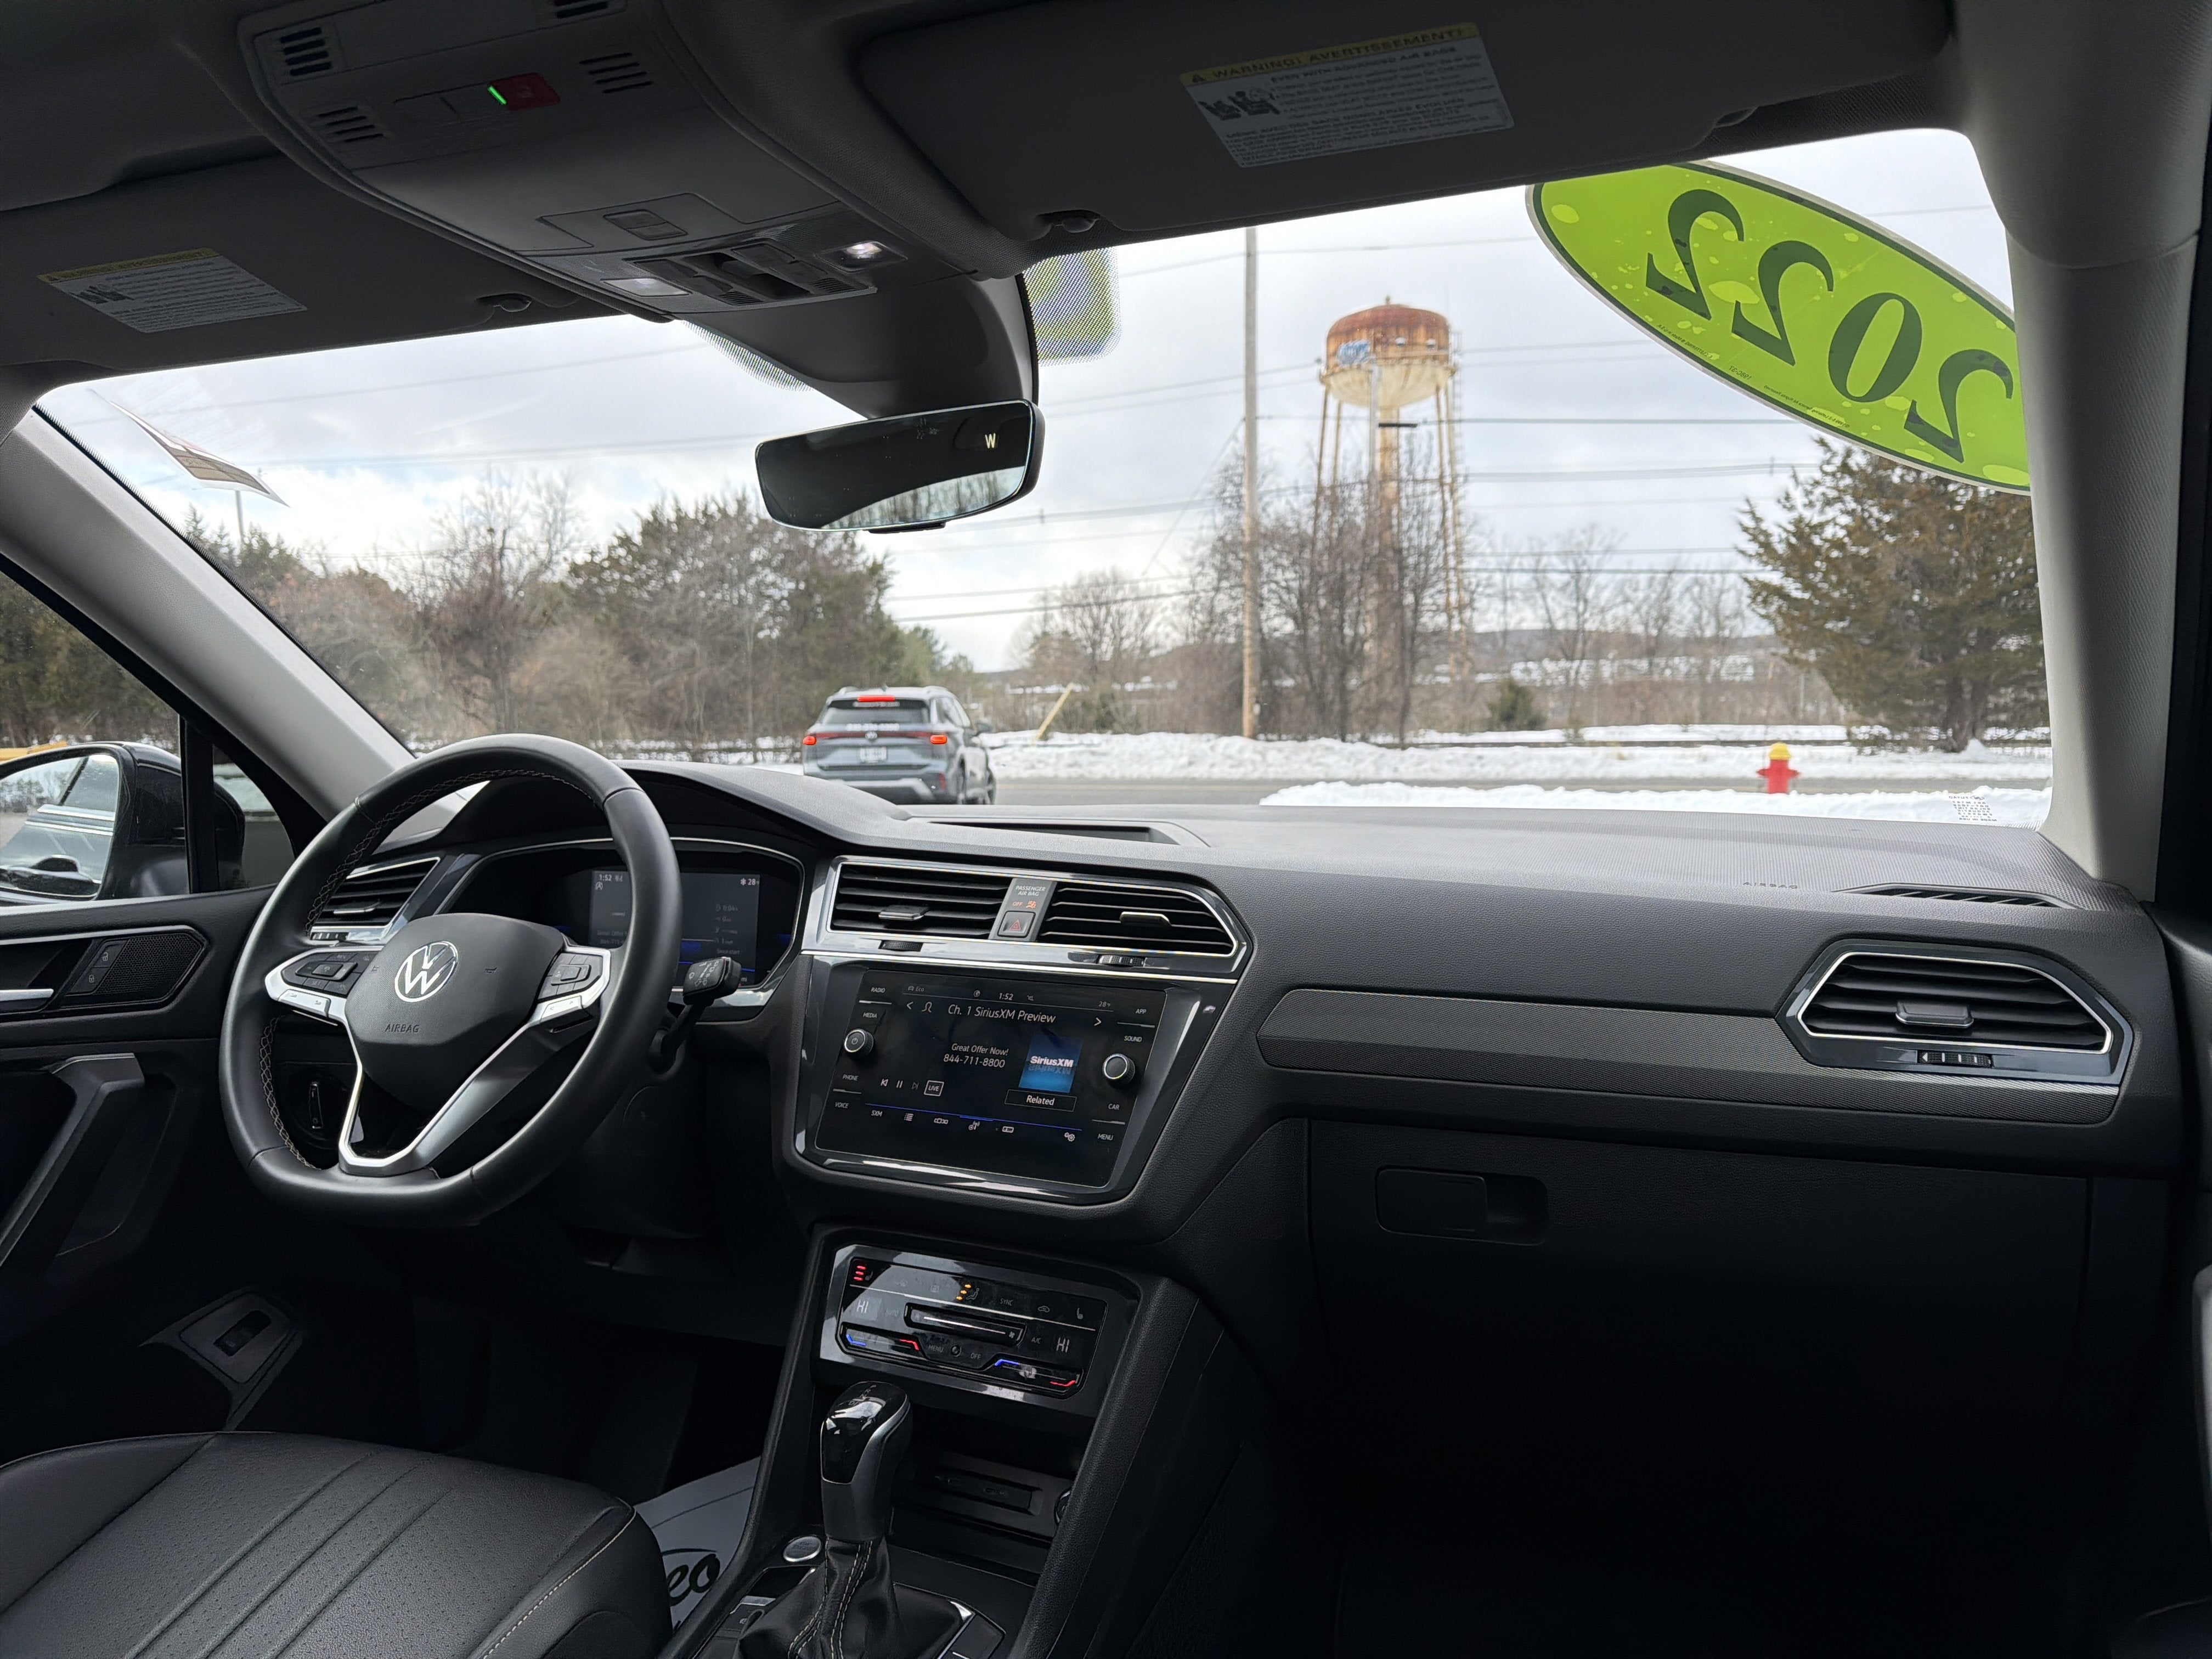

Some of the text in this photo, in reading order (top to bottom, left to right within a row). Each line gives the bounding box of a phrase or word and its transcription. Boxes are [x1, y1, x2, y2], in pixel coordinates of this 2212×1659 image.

[1213, 29, 1463, 78] WARNING! AVERTISSEMENT!
[985, 433, 996, 449] W
[1743, 881, 1798, 889] AIRBAG
[998, 992, 1013, 1001] 1:52
[948, 1004, 1056, 1023] Ch. 1 SiriusXM Preview
[385, 1024, 420, 1033] AIRBAG
[951, 1043, 1009, 1056] Great Offer Now!
[943, 1054, 1006, 1068] 844-711-8800
[1030, 1056, 1074, 1068] SiriusXM
[1026, 1095, 1054, 1105] Related
[856, 1300, 869, 1313] HI
[1000, 1298, 1013, 1306] SYNC
[928, 1345, 944, 1353] MENU
[1056, 1337, 1070, 1353] HI
